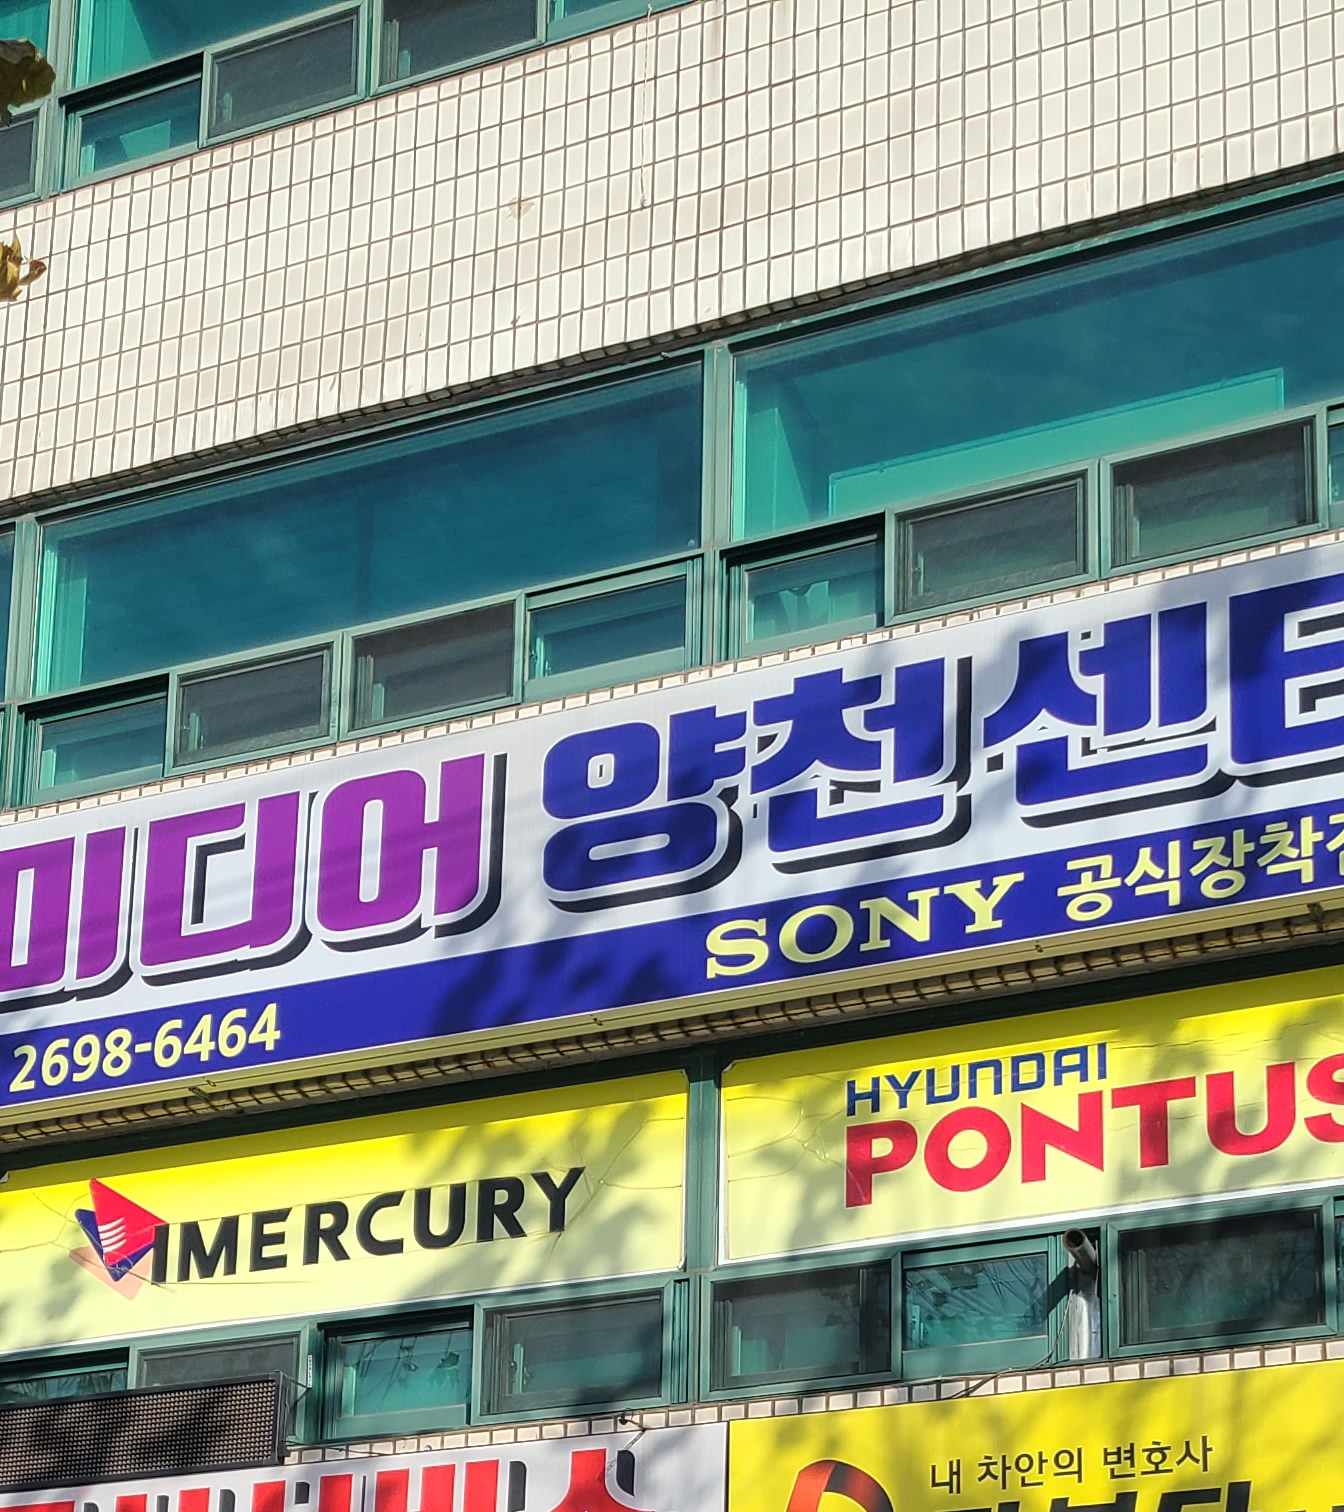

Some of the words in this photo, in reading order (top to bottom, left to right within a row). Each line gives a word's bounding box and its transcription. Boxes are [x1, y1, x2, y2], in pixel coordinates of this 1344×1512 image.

[542, 657, 966, 910] 양천
[705, 872, 1024, 979] SONY
[9, 1003, 282, 1093] 2698-6464
[846, 1042, 1108, 1115] HYUNDAI
[930, 1462, 962, 1496] 내
[978, 1447, 1084, 1490] 차안의
[1102, 1437, 1214, 1478] 변호사
